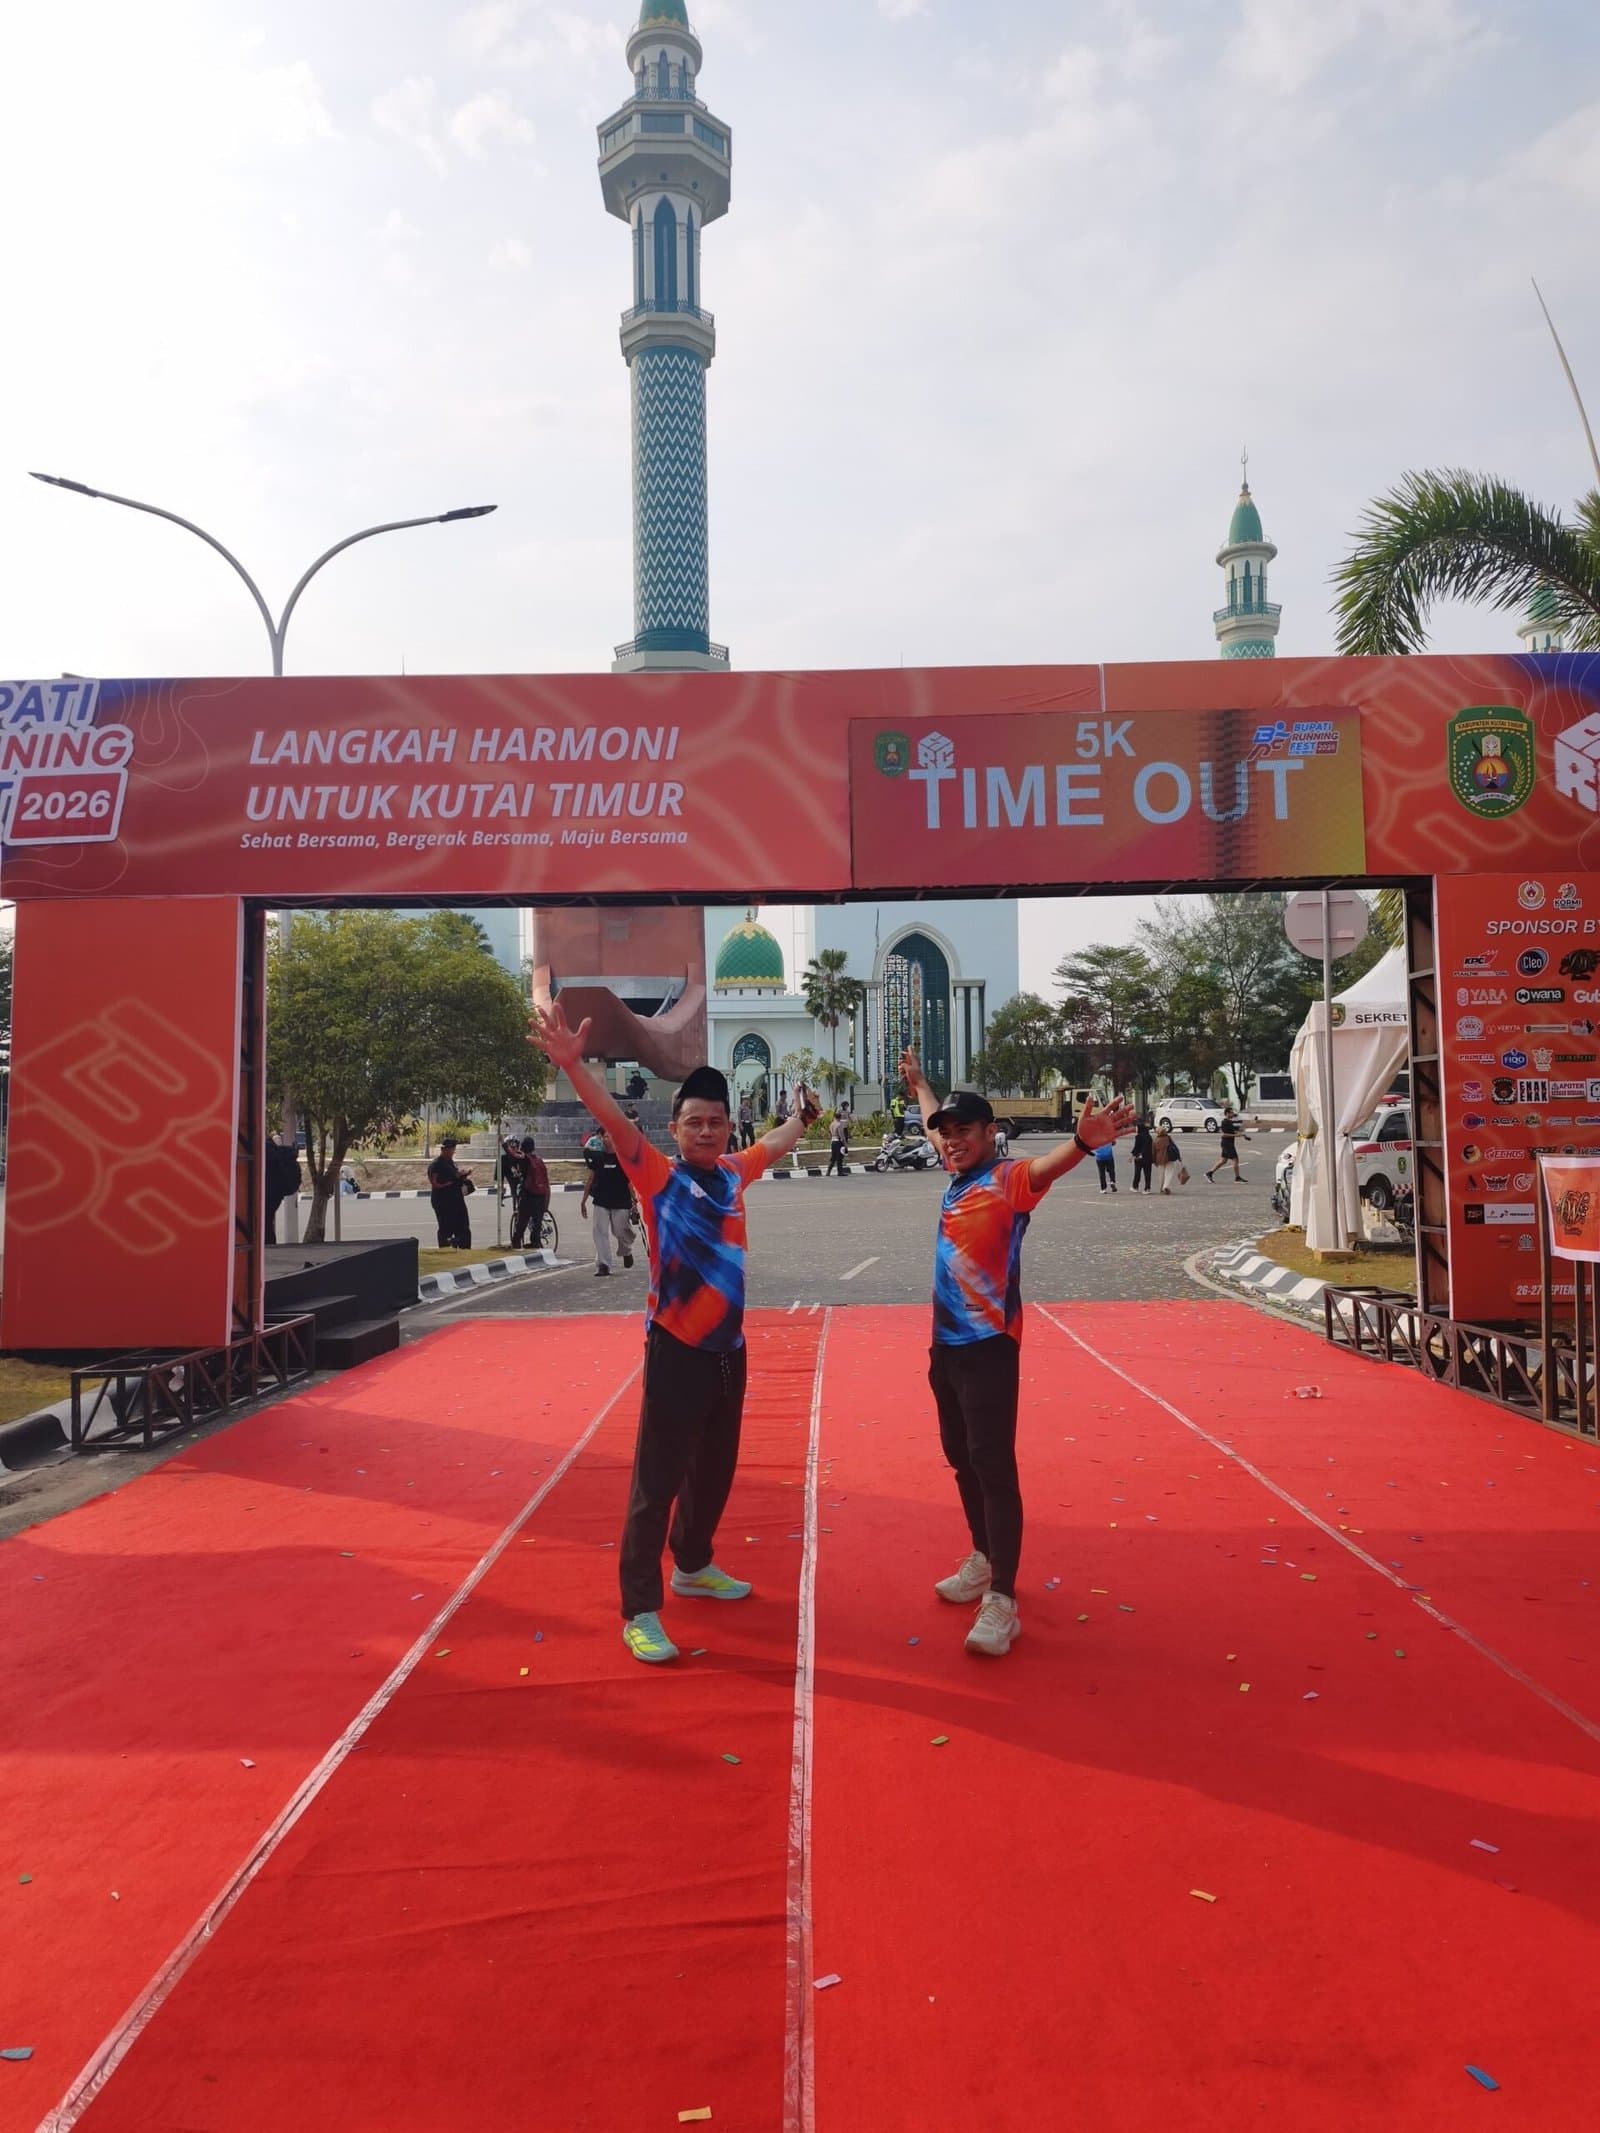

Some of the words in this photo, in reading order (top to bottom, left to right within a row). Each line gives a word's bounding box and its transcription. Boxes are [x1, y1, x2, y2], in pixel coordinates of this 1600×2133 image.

[1294, 722, 1332, 732] BUPATI
[1076, 721, 1136, 759] 5K
[1290, 732, 1338, 741] RUNNING
[249, 729, 457, 765] LANGKAH
[469, 726, 679, 763] HARMONI
[1289, 741, 1316, 751] FEST
[245, 785, 398, 821] UNTUK
[407, 783, 535, 819] KUTAI
[549, 781, 685, 817] TIMUR
[909, 765, 1104, 829] TIME
[1132, 760, 1304, 825] OUT
[21, 791, 112, 821] 2026
[240, 832, 292, 849] Sehat
[297, 832, 381, 850] Bersama,
[386, 831, 467, 851] Bergerak
[472, 830, 554, 848] Bersama,
[560, 829, 605, 848] Maju
[610, 829, 688, 846] Bersama
[1486, 920, 1577, 935] SPONSOR
[1464, 957, 1485, 965] KPC
[1523, 956, 1542, 969] Cleo
[1470, 988, 1508, 1001] YARA
[1531, 990, 1562, 999] wana
[1355, 1013, 1408, 1024] SEKRET
